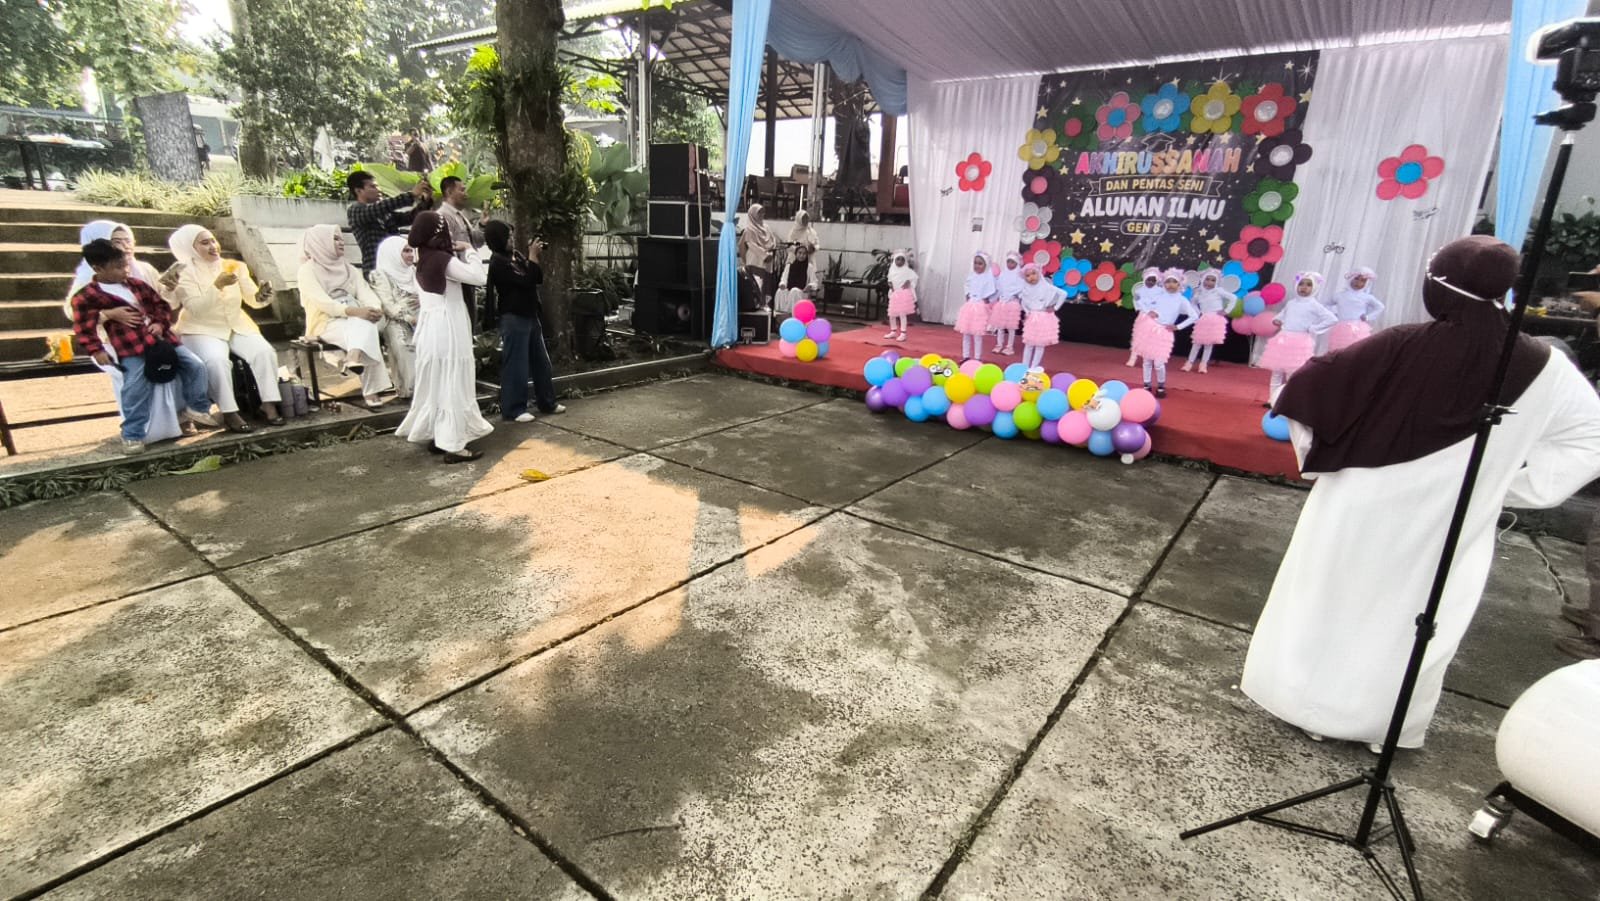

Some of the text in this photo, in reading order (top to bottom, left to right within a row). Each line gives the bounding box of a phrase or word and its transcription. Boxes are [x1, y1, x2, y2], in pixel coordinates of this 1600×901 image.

[1075, 147, 1242, 175] AKHIRUSSANAH
[1106, 179, 1204, 191] DAN PENTAS SENI
[1080, 197, 1226, 221] ALUNAN ILMU
[1127, 222, 1160, 234] GEN 8
